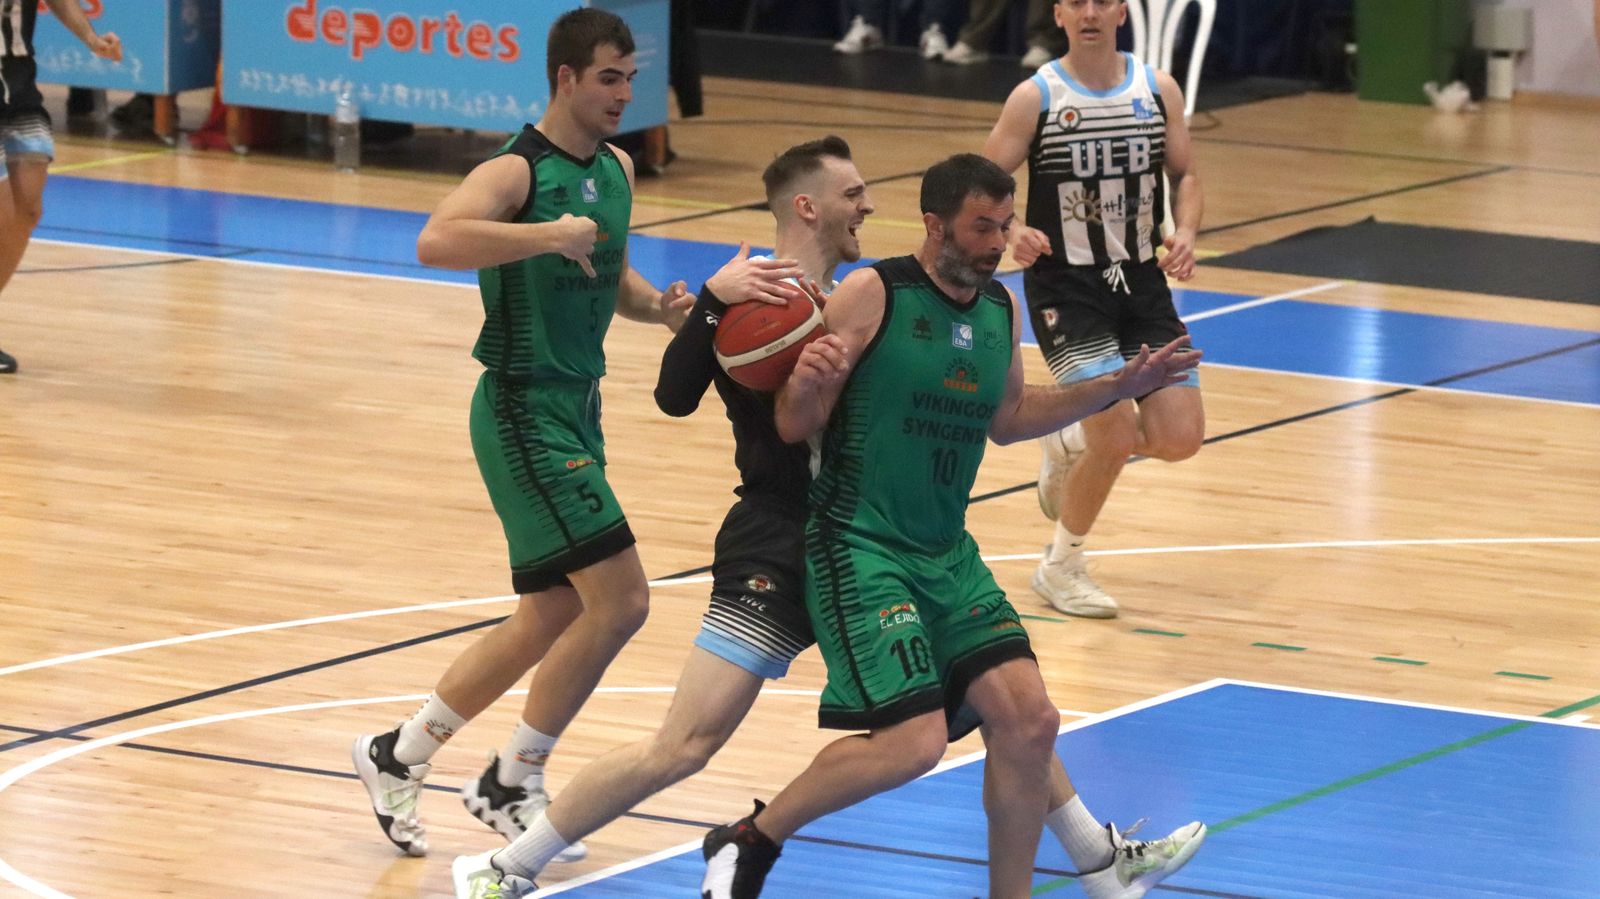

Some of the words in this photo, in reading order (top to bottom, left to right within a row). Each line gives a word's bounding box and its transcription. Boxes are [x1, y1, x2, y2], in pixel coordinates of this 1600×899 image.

[286, 0, 520, 62] deportes
[1068, 136, 1150, 178] ULB
[590, 298, 599, 332] 5
[931, 447, 959, 487] 10
[576, 480, 604, 514] 5
[880, 617, 894, 629] EL
[889, 636, 930, 680] 10
